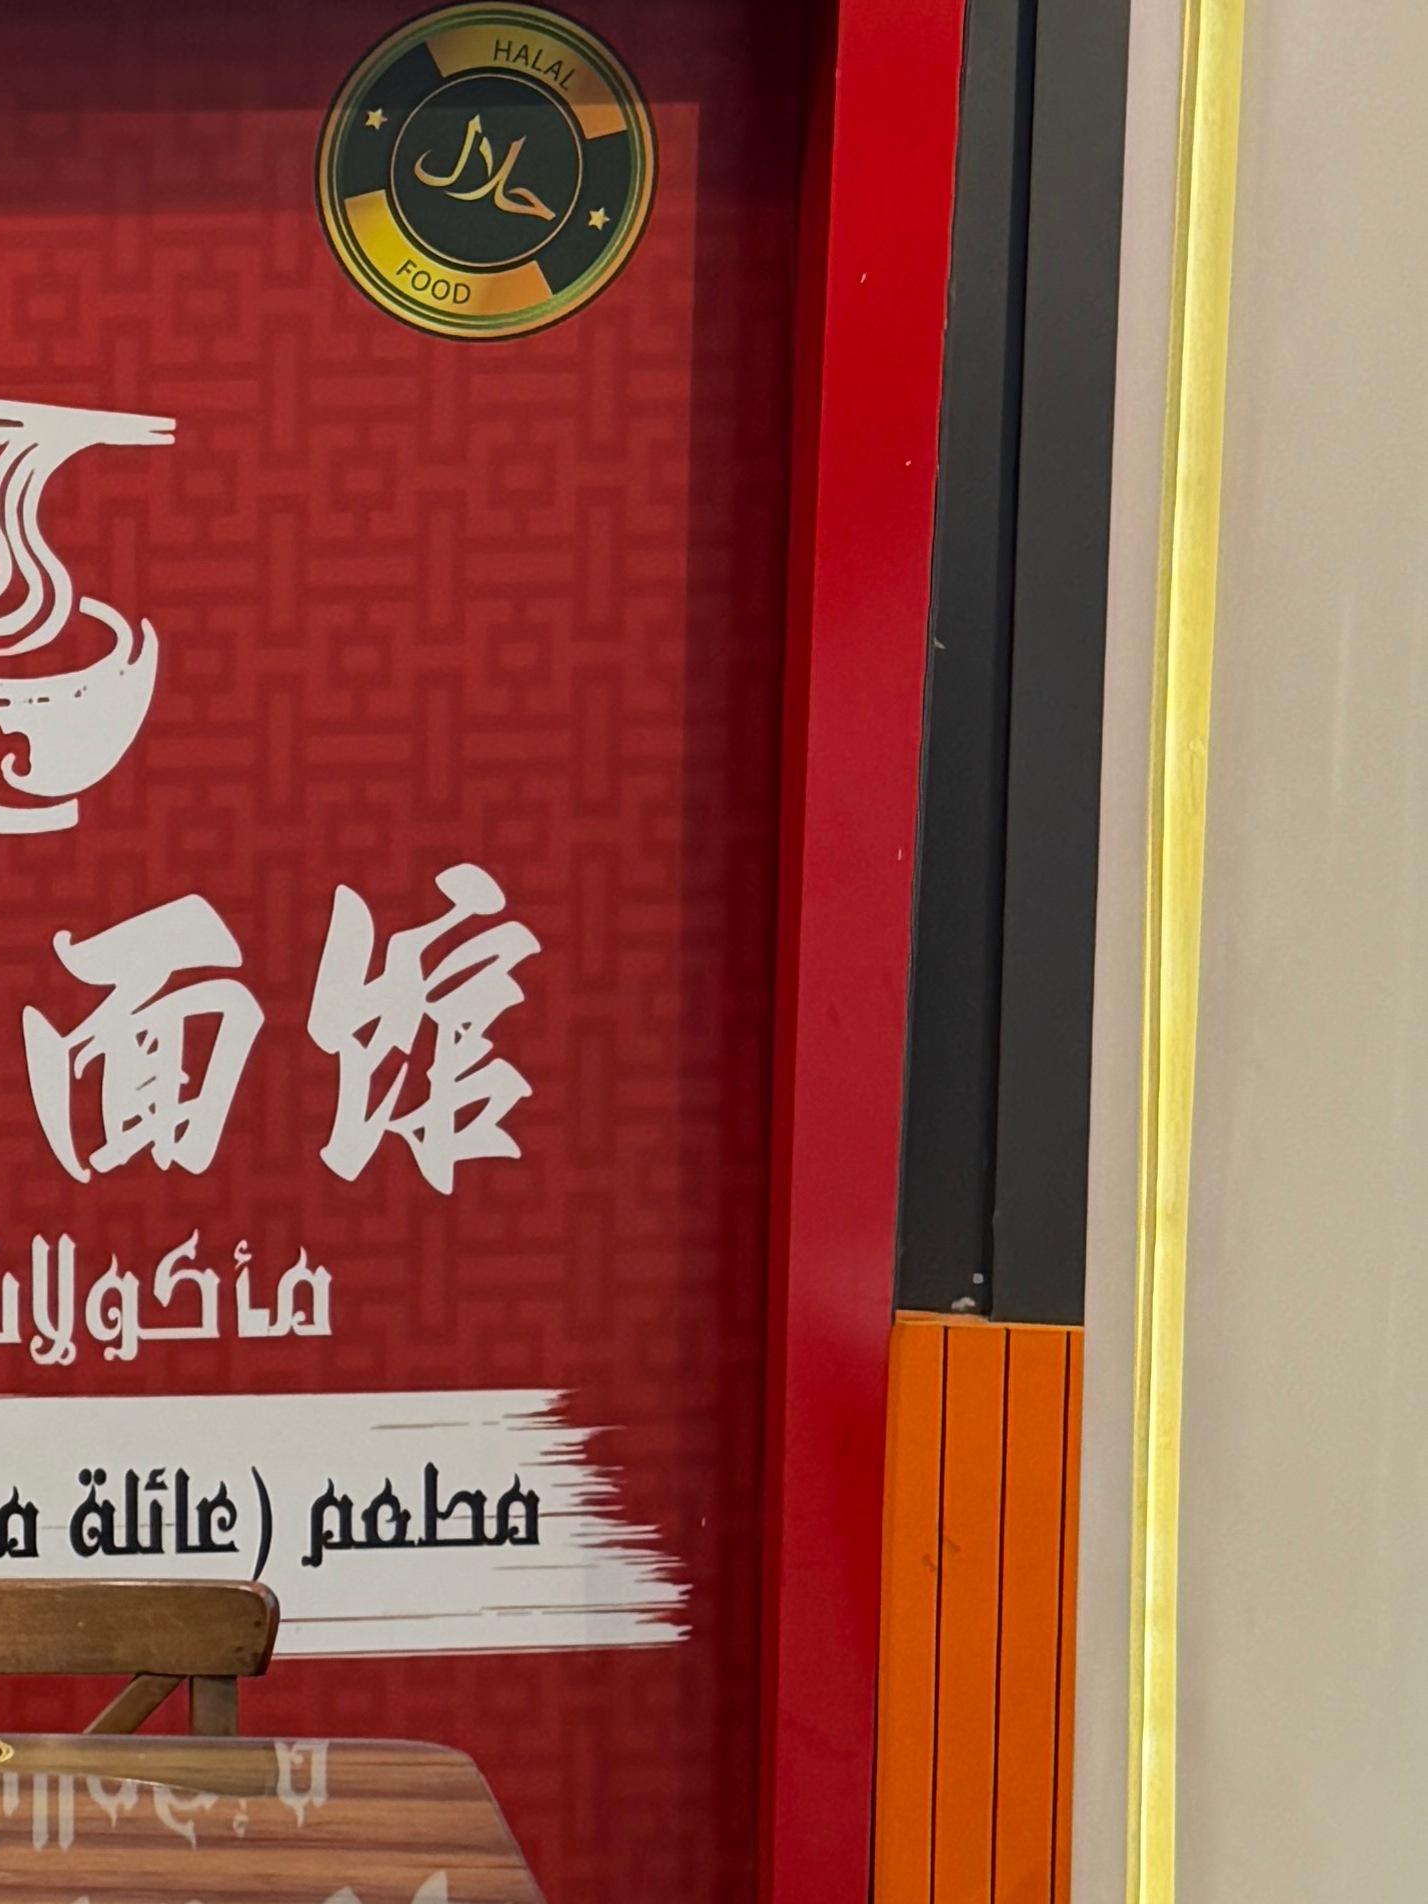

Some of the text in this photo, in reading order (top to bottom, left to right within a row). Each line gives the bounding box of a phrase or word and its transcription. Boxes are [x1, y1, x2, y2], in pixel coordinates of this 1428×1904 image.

[493, 39, 577, 92] HALAL
[413, 113, 557, 221] حلال
[396, 259, 472, 305] FOOD
[301, 1461, 541, 1569] مطعم
